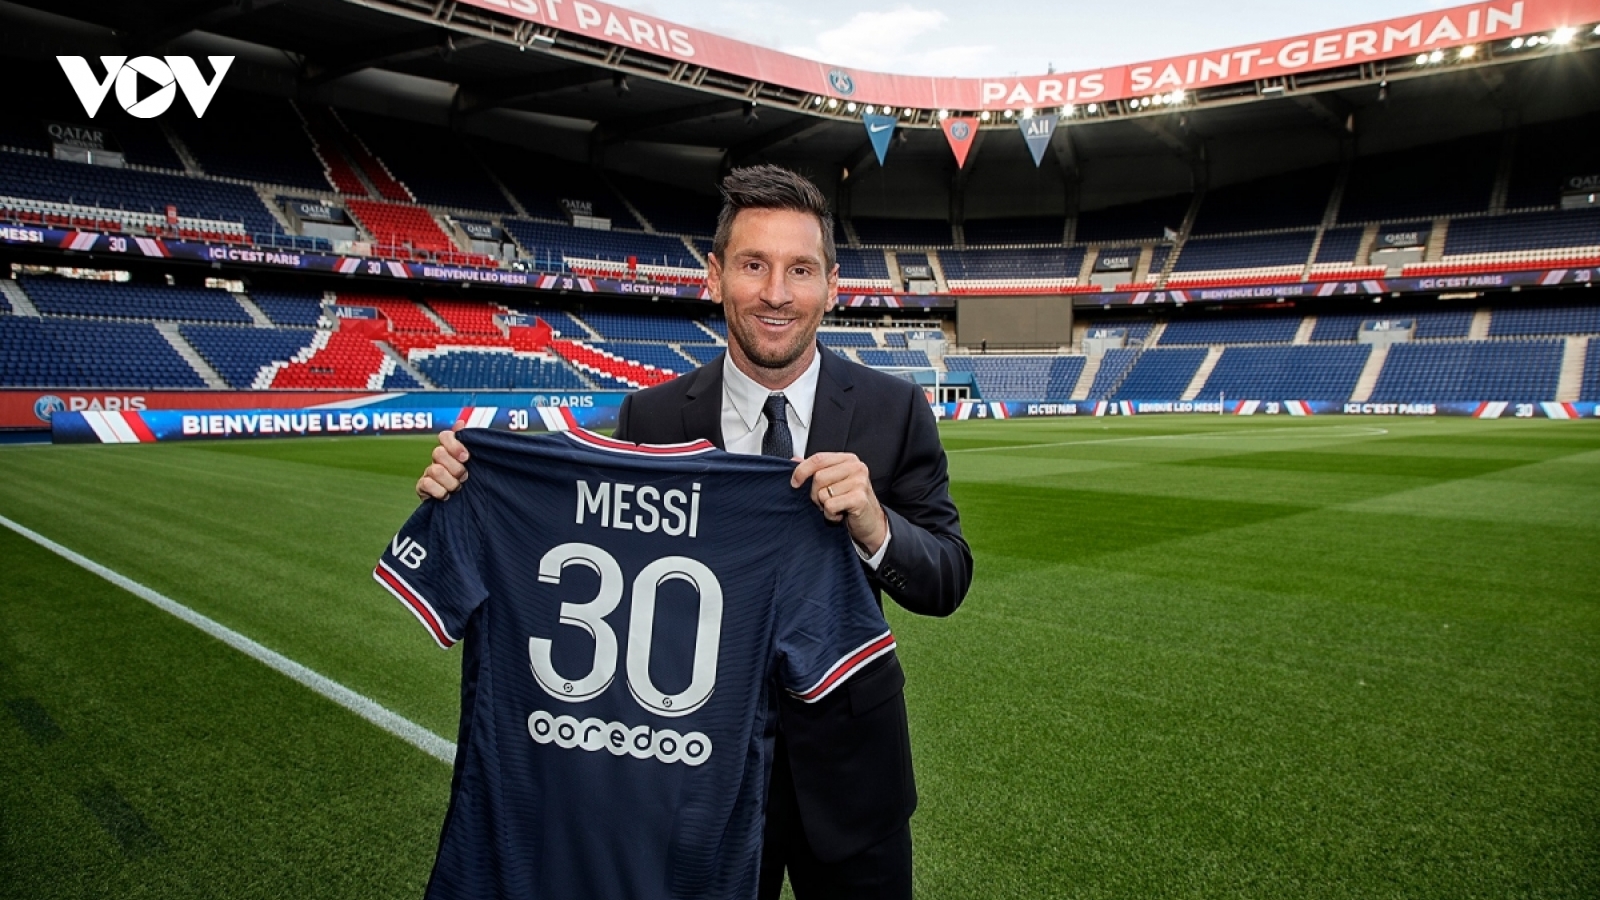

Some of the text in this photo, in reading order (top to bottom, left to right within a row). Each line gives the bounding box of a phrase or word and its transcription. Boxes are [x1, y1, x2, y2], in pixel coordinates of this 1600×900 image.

[484, 0, 695, 58] ST PARIS
[982, 2, 1525, 105] PARIS SAINT-GERMAIN
[48, 123, 103, 143] QATAR
[1570, 175, 1600, 188] QAT
[300, 203, 330, 216] QATAR
[0, 228, 43, 243] MESSI
[467, 225, 492, 234] QATAR
[108, 236, 127, 252] 30
[209, 247, 300, 266] ICI C'EST PARIS
[367, 261, 381, 275] 30
[423, 267, 527, 285] BIENVENUE LEO MESSI
[1420, 279, 1436, 289] ICI
[1468, 275, 1503, 286] PARIS
[1574, 269, 1591, 282] 30
[562, 278, 573, 290] 30
[1201, 285, 1303, 300] BIENVENUE LEO MESSI
[69, 396, 147, 411] PARIS
[550, 396, 594, 407] PARIS
[1174, 402, 1192, 412] LEO
[1265, 402, 1280, 414] 30
[1343, 403, 1436, 414] ICI C'EST PARIS
[977, 404, 987, 417] 30
[1515, 403, 1533, 417] 30
[182, 411, 433, 434] BIENVENUE LEO MESSI
[508, 410, 529, 430] 30
[528, 543, 724, 718] 30
[532, 715, 707, 761] ooredoo
